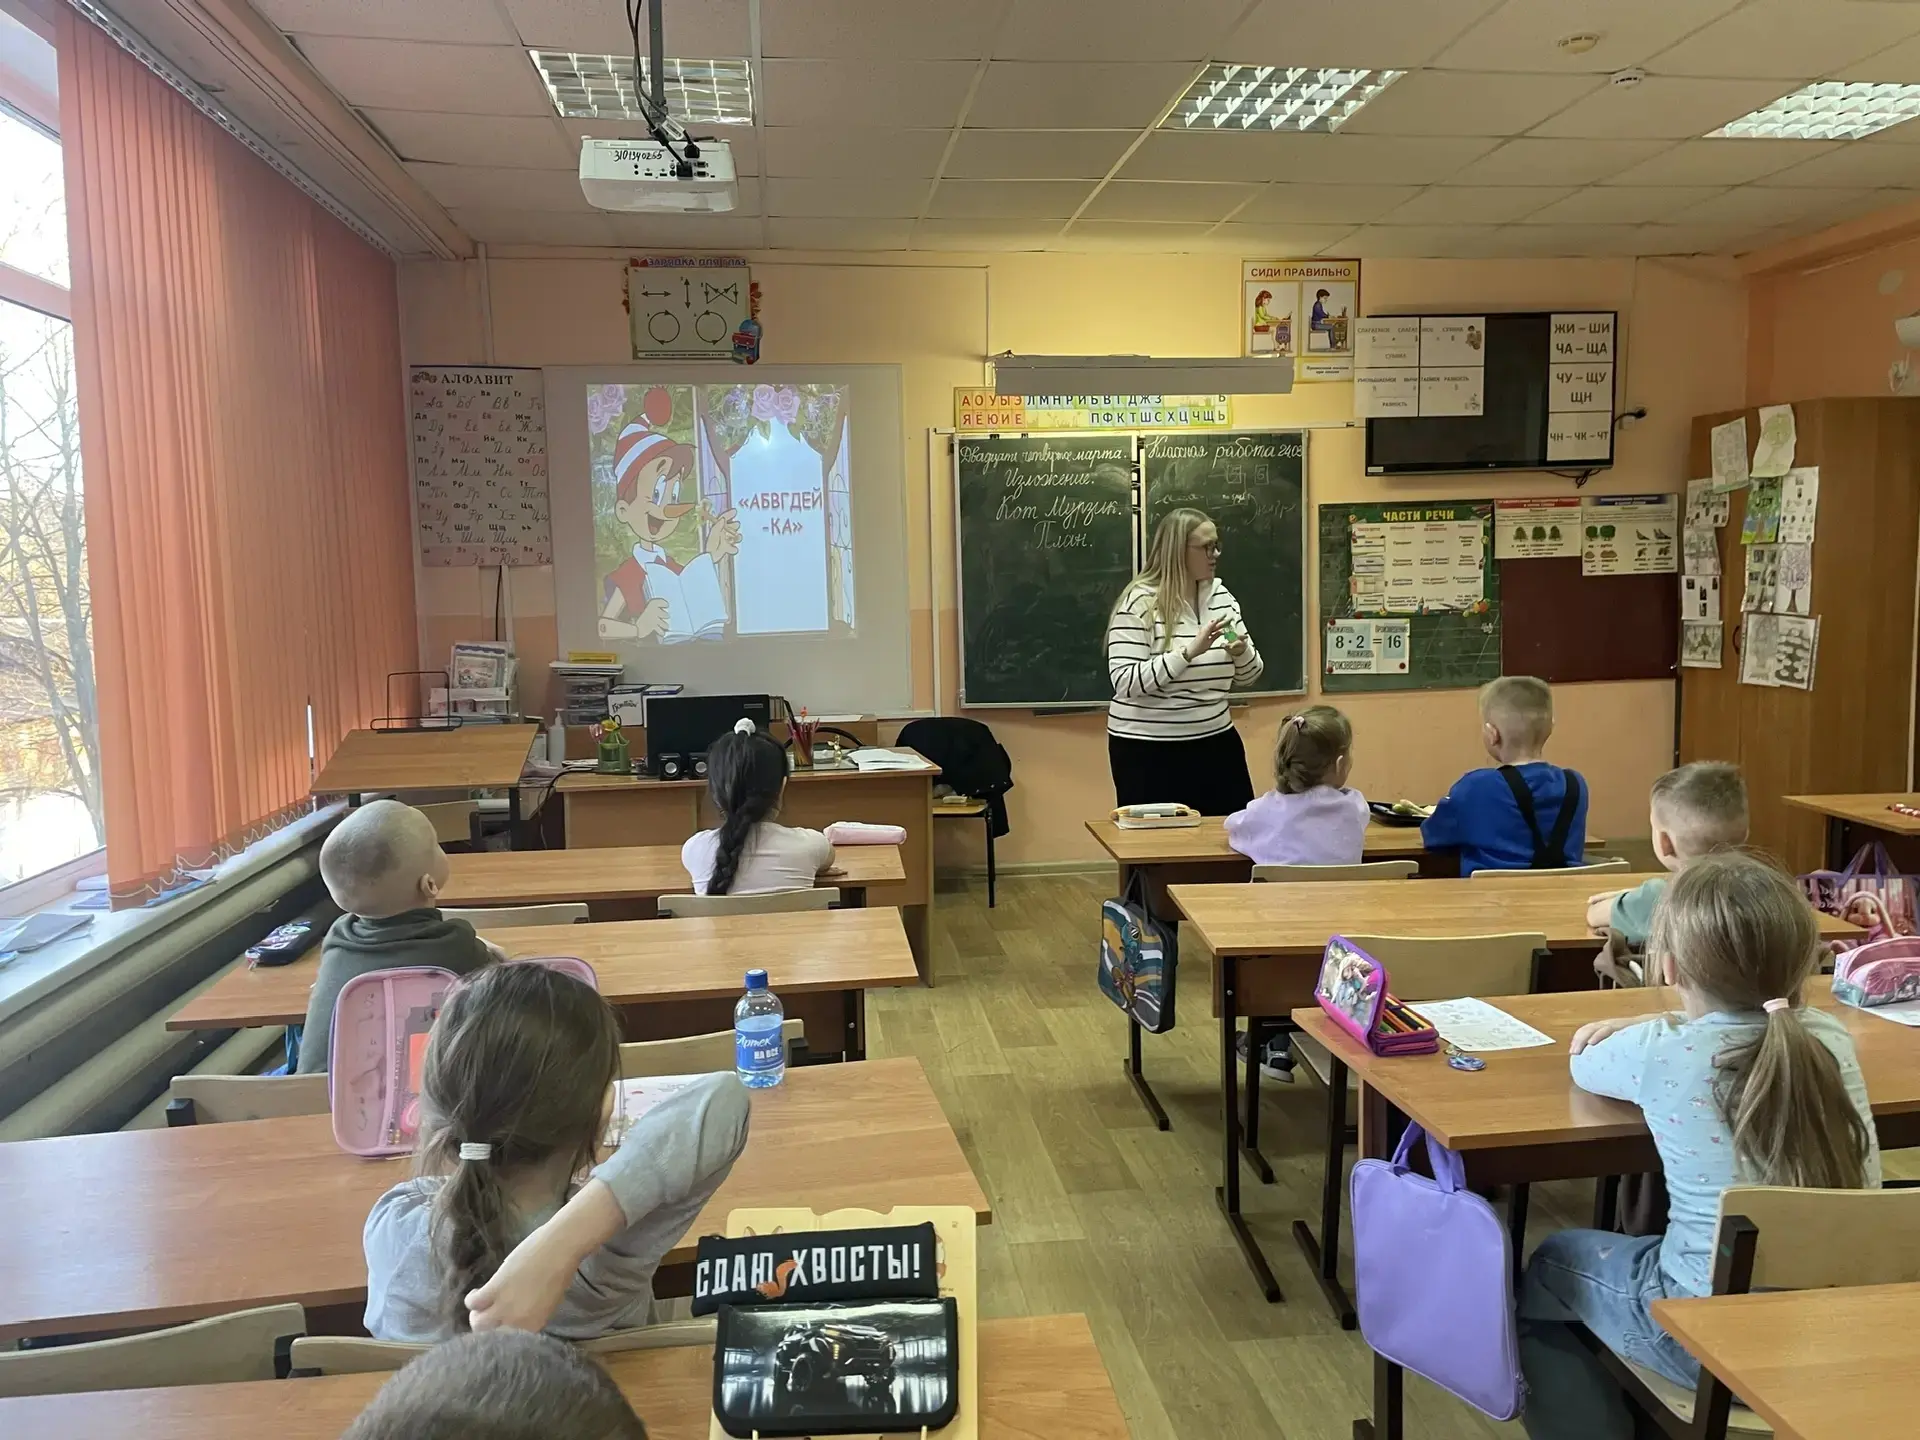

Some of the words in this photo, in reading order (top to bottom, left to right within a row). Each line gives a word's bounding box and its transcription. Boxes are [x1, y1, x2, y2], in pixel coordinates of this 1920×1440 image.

[1251, 268, 1280, 277] СИДИ
[1284, 268, 1351, 277] ПРАВИЛЬНО
[1554, 324, 1575, 334] ЖИ
[1589, 323, 1610, 333] ШИ
[1556, 343, 1572, 354] ЧА
[1587, 343, 1607, 355] ЩА
[442, 374, 513, 384] АЛФАВИТ
[1557, 373, 1572, 383] ЧУ
[1587, 372, 1606, 384] ЩУ
[1571, 392, 1592, 404] ЩН
[1550, 433, 1563, 441] ЧН
[1597, 432, 1608, 440] ЧТ
[1212, 438, 1275, 468] работа
[996, 495, 1037, 520] Кот
[1383, 511, 1420, 521] ЧАСТИ
[1426, 510, 1455, 520] РЕЧИ
[1336, 635, 1344, 649] 8
[1356, 635, 1364, 648] 2
[1388, 635, 1401, 648] 16
[695, 1252, 774, 1299] СДАЮ
[790, 1243, 920, 1287] ХВОСТЫ!
